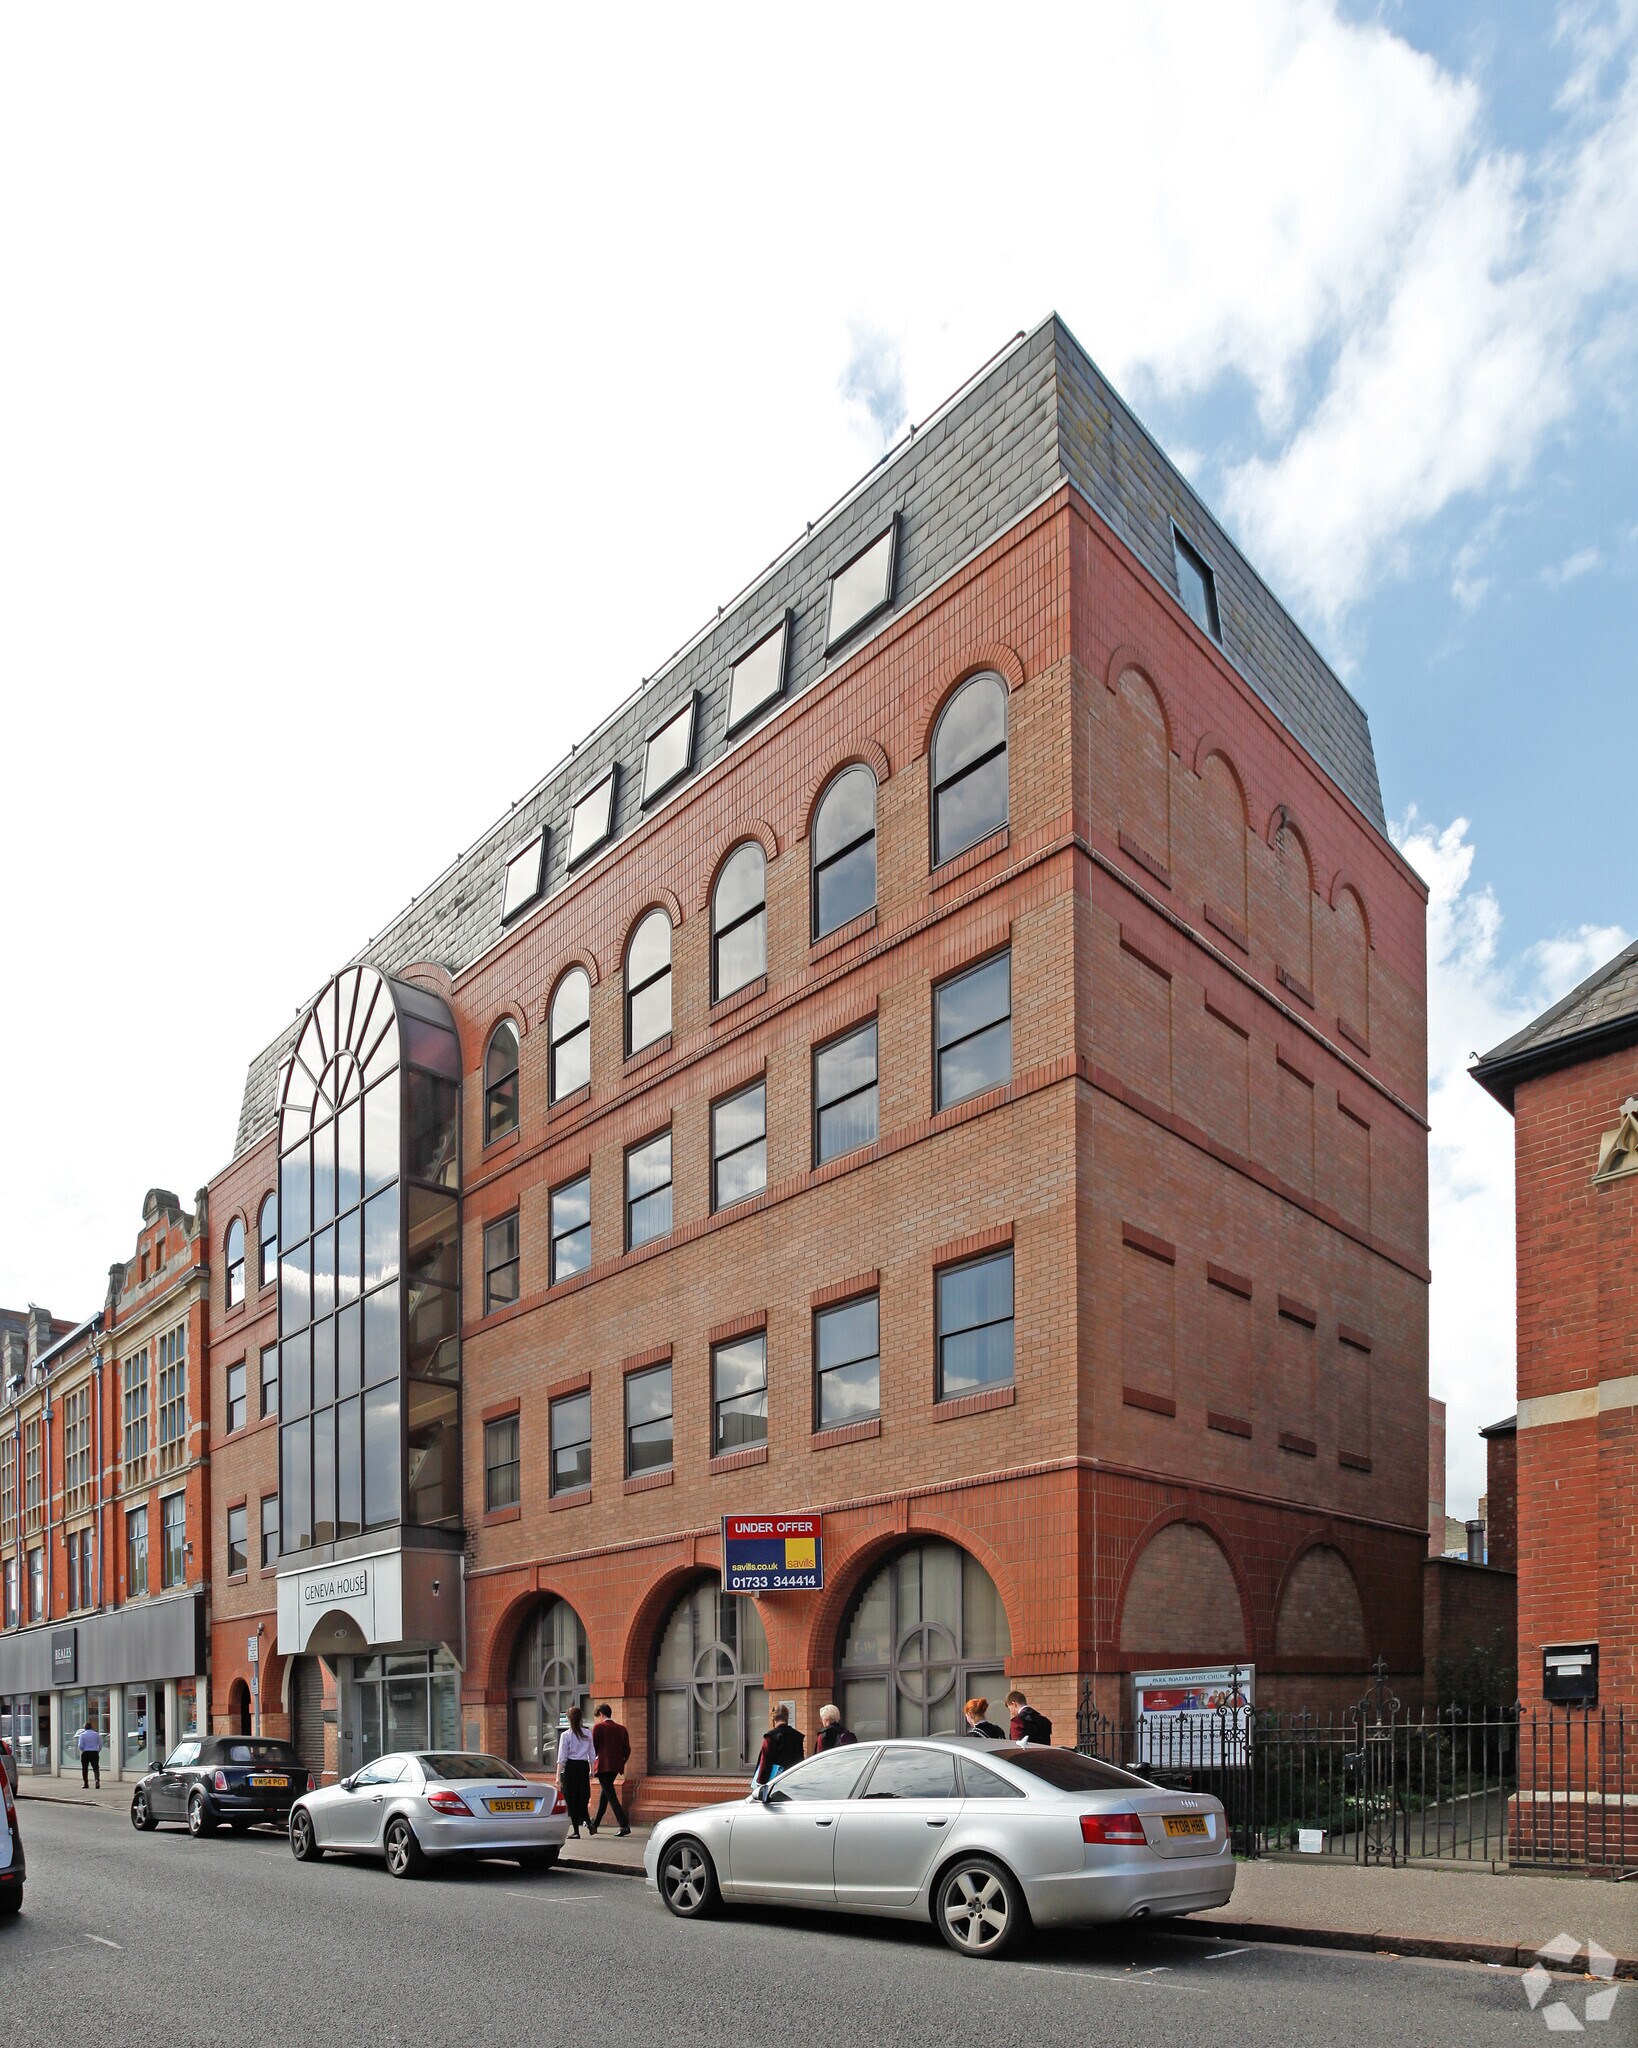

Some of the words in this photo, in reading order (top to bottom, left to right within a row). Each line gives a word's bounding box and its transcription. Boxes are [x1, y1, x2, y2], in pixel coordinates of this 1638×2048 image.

[735, 1523, 773, 1533] UNDER
[777, 1522, 813, 1532] OFFER
[732, 1562, 778, 1571] savills.co.uk
[787, 1558, 815, 1568] savills
[732, 1576, 768, 1588] 01733
[773, 1575, 816, 1587] 344414
[304, 1582, 335, 1600] GENEVA
[337, 1575, 365, 1594] HOUSE
[55, 1647, 71, 1659] BEALES
[515, 1801, 531, 1810] EEZ
